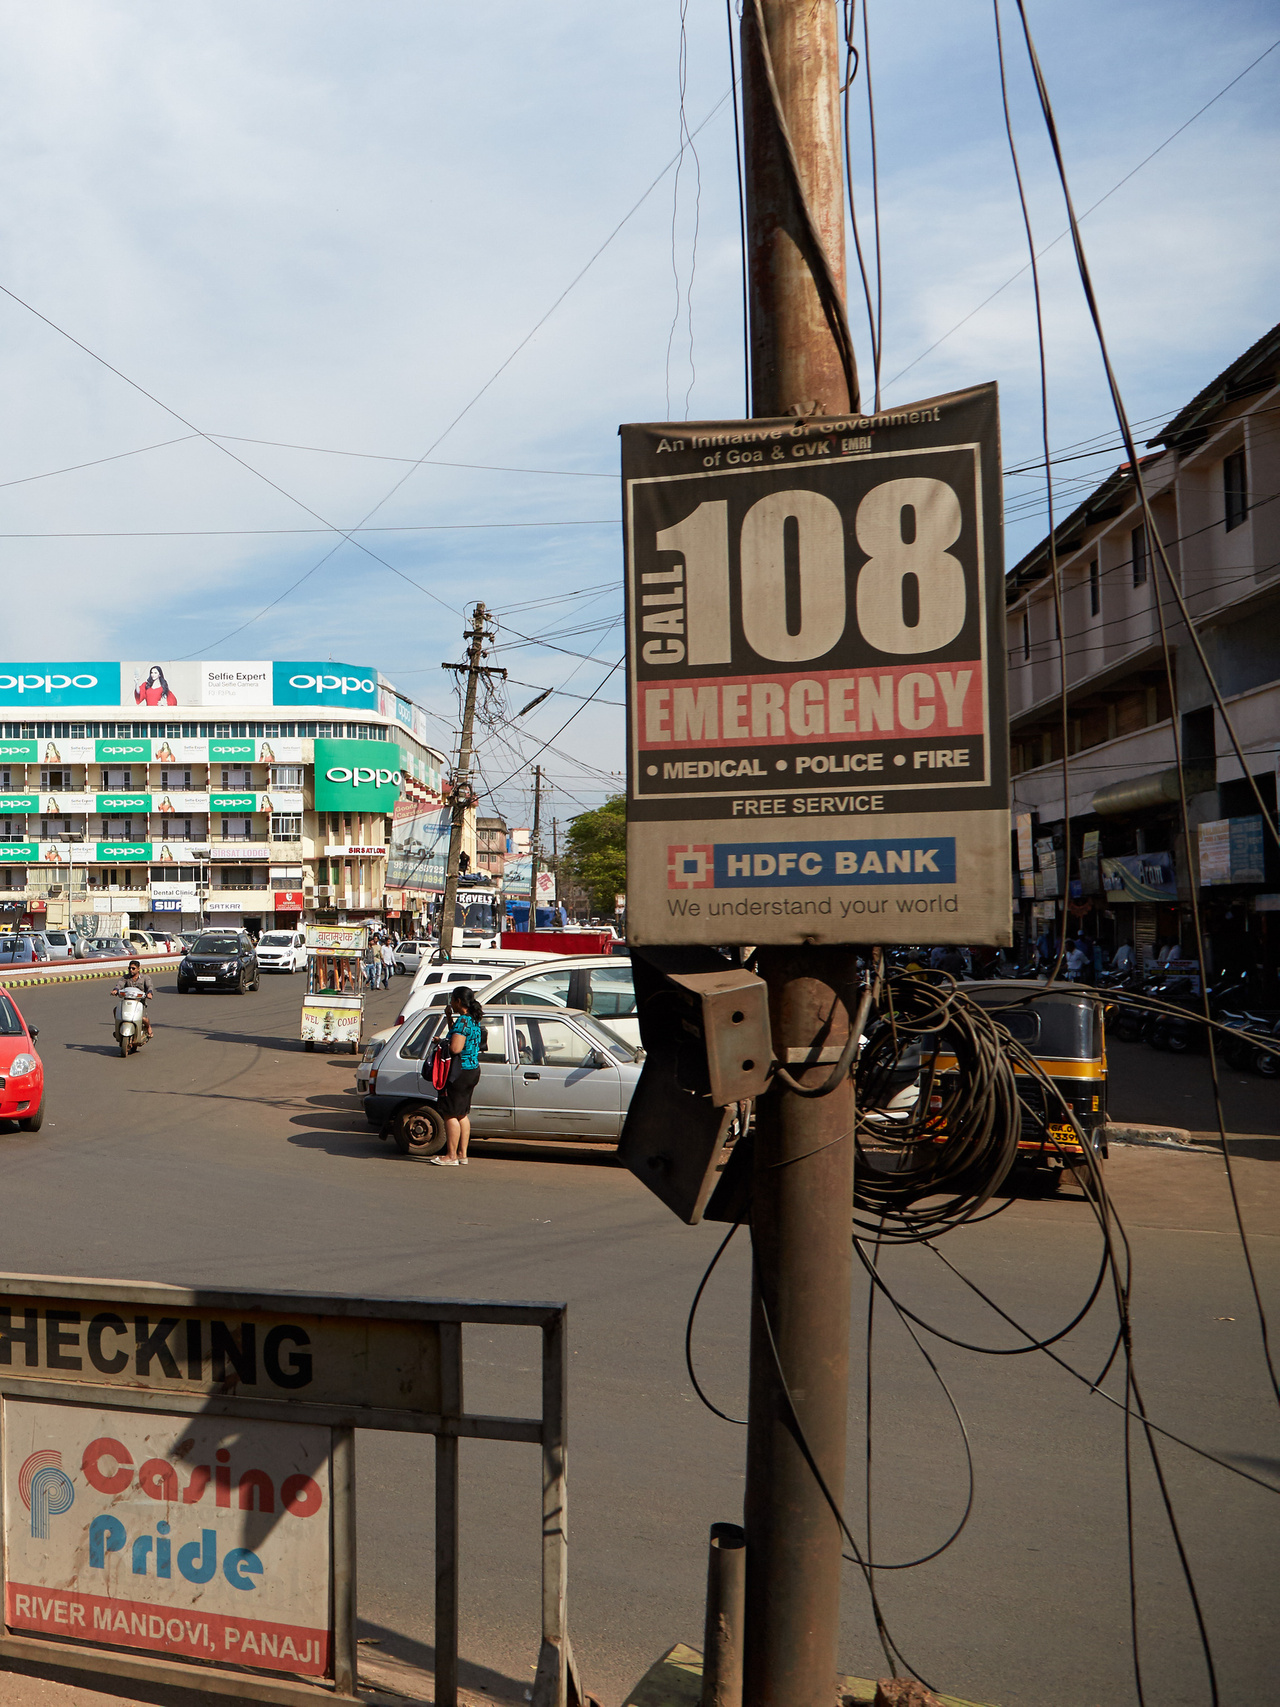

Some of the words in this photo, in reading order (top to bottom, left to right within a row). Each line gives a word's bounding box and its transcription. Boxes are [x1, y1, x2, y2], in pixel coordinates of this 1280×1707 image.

[656, 438, 685, 453] An
[691, 429, 782, 450] Initiative
[789, 426, 811, 438] of
[820, 407, 940, 433] Government
[703, 452, 722, 467] of
[726, 451, 763, 465] Goa
[771, 447, 785, 460] &
[792, 441, 831, 457] GVK
[842, 435, 872, 451] EMRI
[656, 477, 967, 666] 108
[642, 565, 685, 665] CALL
[236, 673, 266, 681] Expert
[289, 674, 375, 694] oppo
[644, 670, 973, 743] EMERGENCY
[102, 746, 144, 755] oppo
[213, 746, 251, 754] oppo
[663, 759, 767, 780] MEDICAL
[795, 753, 883, 774] POLICE
[913, 749, 970, 769] FIRE
[326, 767, 401, 788] oppo
[103, 799, 144, 808] oppo
[213, 799, 252, 807] oppo
[395, 804, 418, 813] Goods
[732, 799, 786, 816] FREE
[792, 795, 884, 814] SERVICE
[103, 847, 145, 856] oppo
[727, 852, 823, 877] HDFC
[835, 849, 940, 876] BANK
[456, 892, 493, 904] TRAVELS
[668, 899, 701, 917] We
[709, 898, 831, 915] understand
[840, 899, 888, 919] your
[895, 894, 959, 913] world
[337, 1016, 358, 1027] COME
[1051, 1124, 1076, 1132] GA.0
[1052, 1133, 1078, 1141] 339
[82, 1437, 323, 1518] Casino
[89, 1514, 264, 1591] Pride
[15, 1593, 85, 1628] RIVER
[93, 1605, 216, 1652] MANDOVI,
[224, 1627, 321, 1666] PANAJI
